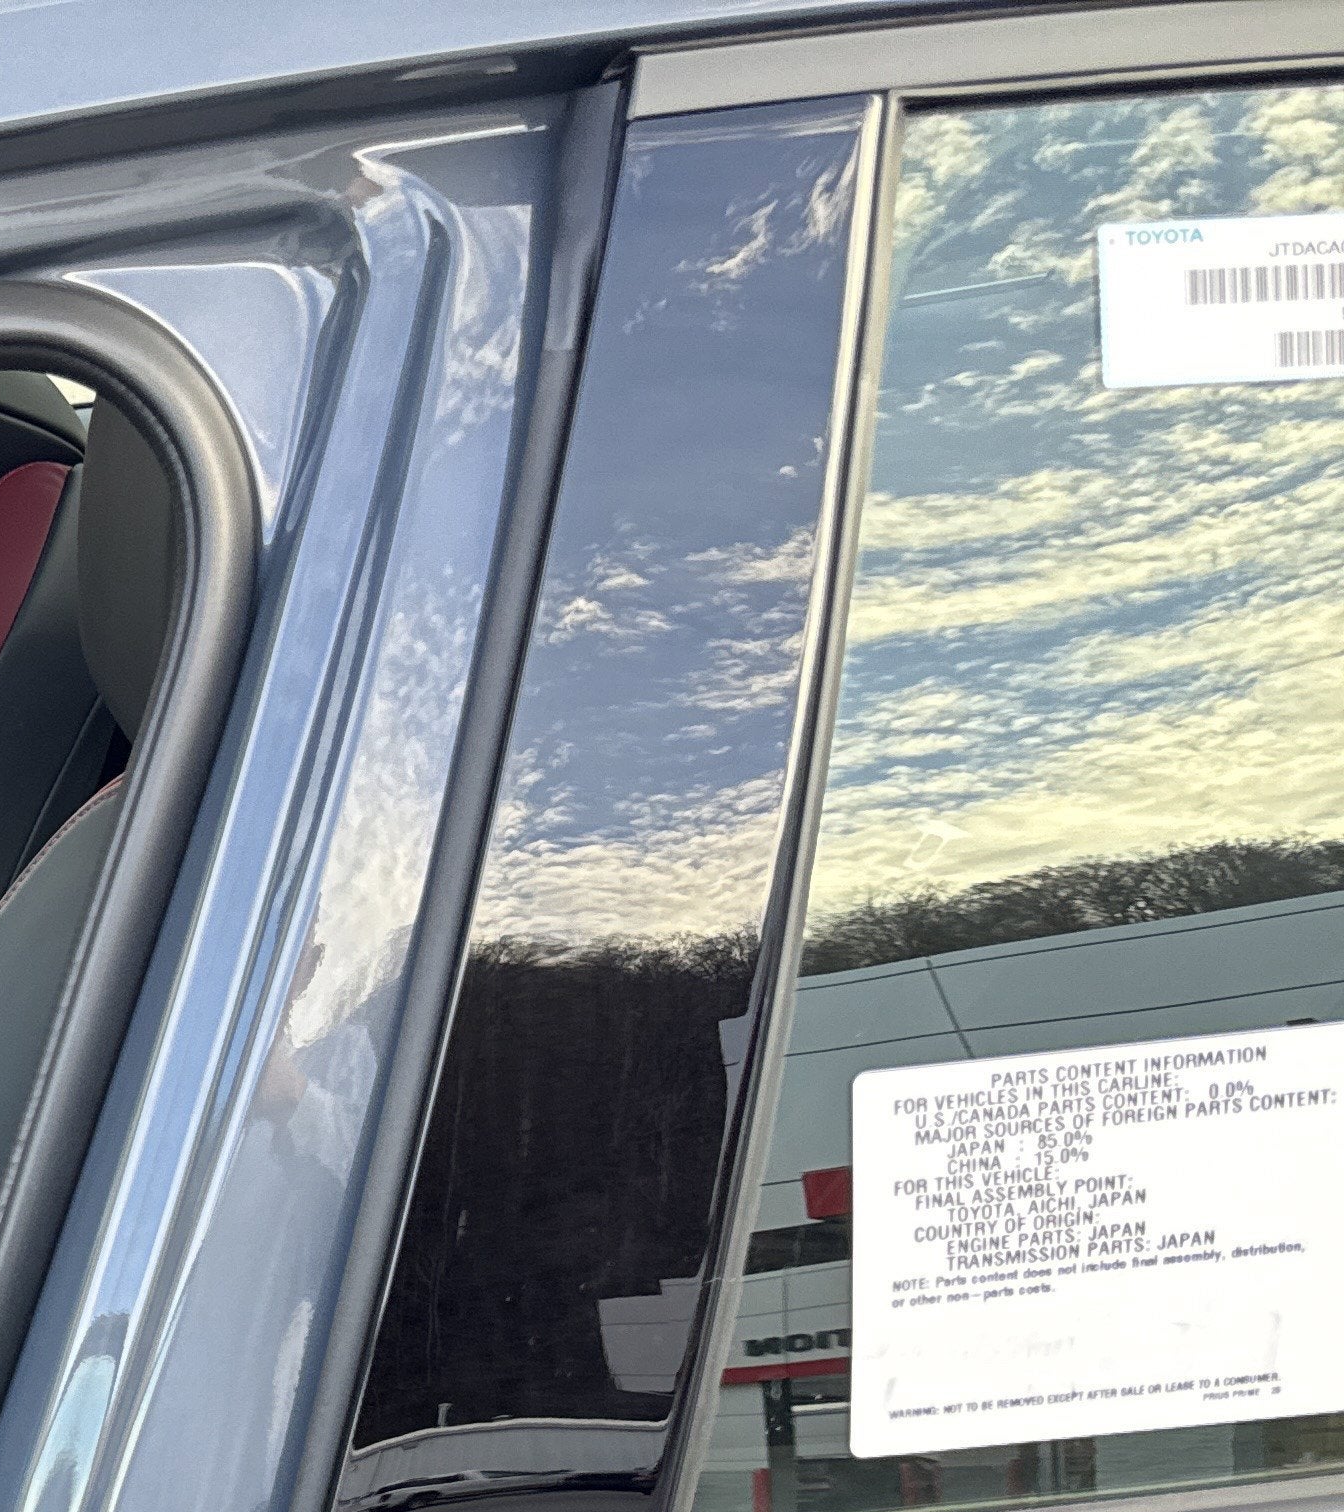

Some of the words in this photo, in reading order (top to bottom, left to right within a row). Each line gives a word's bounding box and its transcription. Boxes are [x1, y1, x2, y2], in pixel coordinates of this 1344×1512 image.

[1125, 228, 1204, 246] TOYOTA
[991, 1068, 1049, 1088] PARTS
[1056, 1059, 1137, 1082] CONTENT
[1144, 1046, 1268, 1072] INFORMATION
[894, 1098, 928, 1115] FOR
[934, 1087, 1019, 1110] VEHICLES
[1026, 1086, 1043, 1101] IN
[1051, 1081, 1091, 1098] THIS
[1098, 1072, 1179, 1094] CARLINE:
[1038, 1096, 1095, 1117] PARTS
[1102, 1087, 1190, 1111] CONTENT:
[914, 1125, 977, 1146] MAJOR
[984, 1116, 1065, 1139] SOURCES
[1073, 1113, 1095, 1130] OF
[1102, 1104, 1177, 1127] FOREIGN
[1185, 1097, 1243, 1118] PARTS
[1249, 1088, 1337, 1112] CONTENT:
[947, 1138, 1005, 1159] JAPAN
[1037, 1130, 1093, 1150] 85.0%
[947, 1156, 1002, 1175] CHINA
[1034, 1146, 1089, 1166] 15.0%
[894, 1179, 928, 1196] FOR
[936, 1174, 974, 1191] THIS
[982, 1166, 1060, 1187] VEHICLE:
[915, 1192, 965, 1211] FINAL
[971, 1180, 1067, 1204] ASSEMBLY
[1074, 1174, 1133, 1193] POINT:
[947, 1202, 1021, 1222] TOYOTA,
[1028, 1195, 1081, 1215] AICHI,
[1088, 1188, 1146, 1209] JAPAN
[914, 1219, 998, 1242] COUNTRY
[1004, 1217, 1026, 1233] OF
[1033, 1210, 1100, 1229] ORIGIN:
[947, 1234, 1010, 1256] ENGINE
[1018, 1228, 1081, 1248] PARTS:
[1088, 1221, 1146, 1242] JAPAN
[892, 1278, 930, 1292] NOTE:
[935, 1275, 967, 1288] Parts
[971, 1270, 1018, 1284] content
[1023, 1266, 1052, 1279] does
[1057, 1263, 1077, 1275] not
[1081, 1260, 1127, 1273] include
[1132, 1255, 1158, 1268] final
[1163, 1249, 1226, 1265] assembly,
[1231, 1241, 1306, 1259] distribution,
[947, 1245, 1080, 1272] TRANSMISSION
[1087, 1237, 1151, 1258] PARTS:
[1157, 1229, 1216, 1252] JAPAN
[892, 1298, 905, 1308] or
[909, 1294, 942, 1307] other
[1018, 1283, 1056, 1295] costs.
[888, 1406, 940, 1420] WARNING:
[943, 1403, 963, 1415] NOT
[966, 1401, 979, 1412] TO
[981, 1400, 993, 1411] BE
[997, 1395, 1044, 1409] REMOVED
[1047, 1391, 1084, 1404] EXCEPT
[1087, 1388, 1118, 1400] AFTER
[1121, 1385, 1145, 1397] SALE
[1148, 1384, 1162, 1394] OR
[1165, 1380, 1195, 1393] LEASE
[1199, 1378, 1211, 1389] TO
[1214, 1377, 1220, 1387] A
[1203, 1391, 1229, 1401] PRIUS
